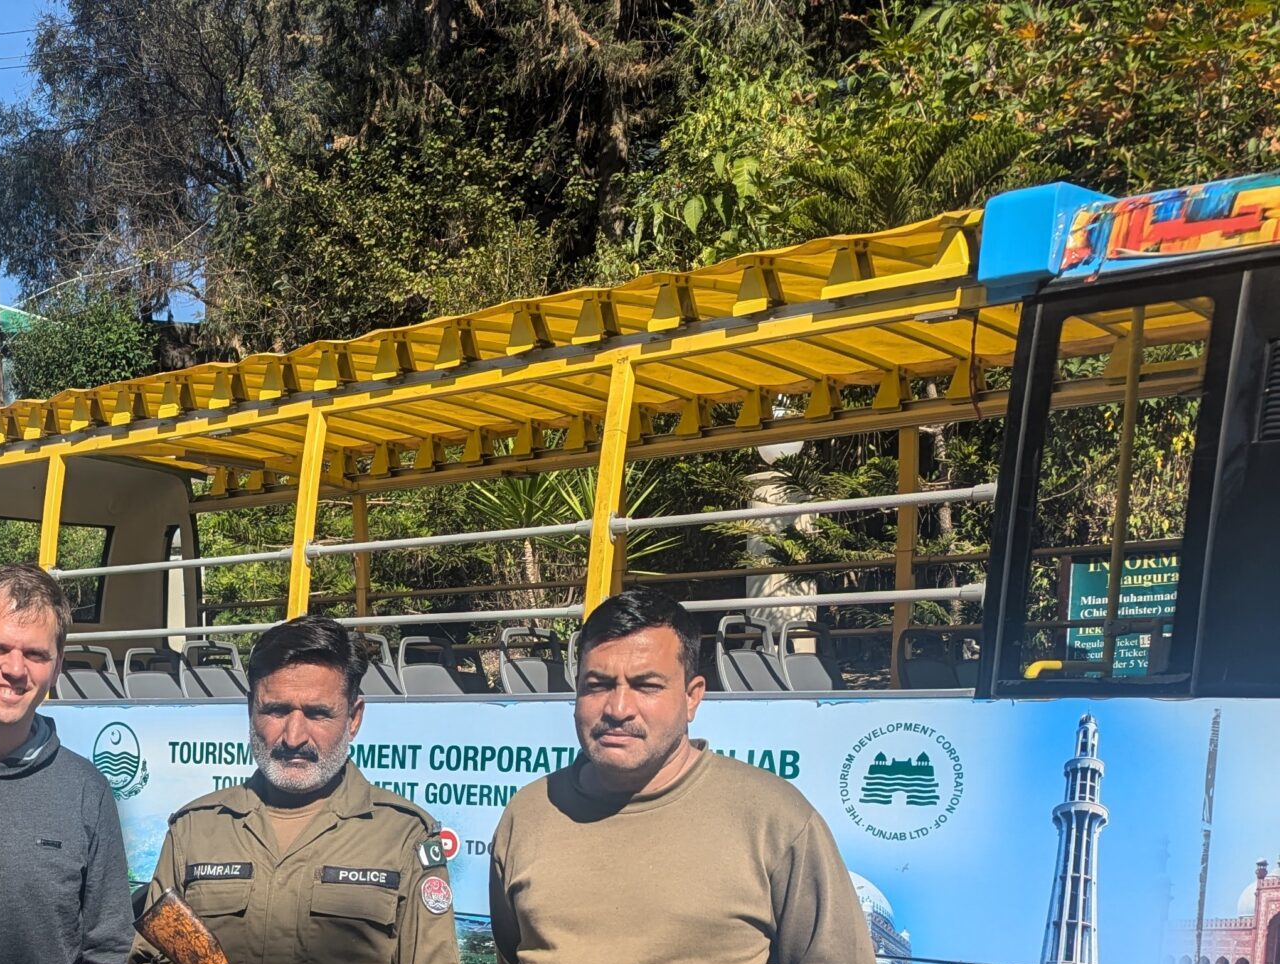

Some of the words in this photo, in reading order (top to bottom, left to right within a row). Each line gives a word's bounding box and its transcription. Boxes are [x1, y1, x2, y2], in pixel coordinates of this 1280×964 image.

[1087, 552, 1178, 573] INORM
[1079, 607, 1108, 619] (Chie
[1078, 626, 1104, 635] Tick
[1074, 639, 1105, 651] Regula
[1115, 638, 1138, 647] icket
[1137, 659, 1149, 668] Ye
[852, 722, 937, 754] DEVELOPMENT
[168, 741, 254, 766] TOURISM
[429, 744, 575, 773] CORPORATI
[839, 753, 856, 804] TOURISM
[935, 734, 965, 814] CORPORATION
[845, 804, 863, 827] THE
[933, 814, 948, 829] OF
[865, 824, 907, 841] PUNJAB
[909, 827, 929, 840] LTD
[193, 864, 241, 879] MUMRAIZ
[338, 870, 388, 884] POLICE
